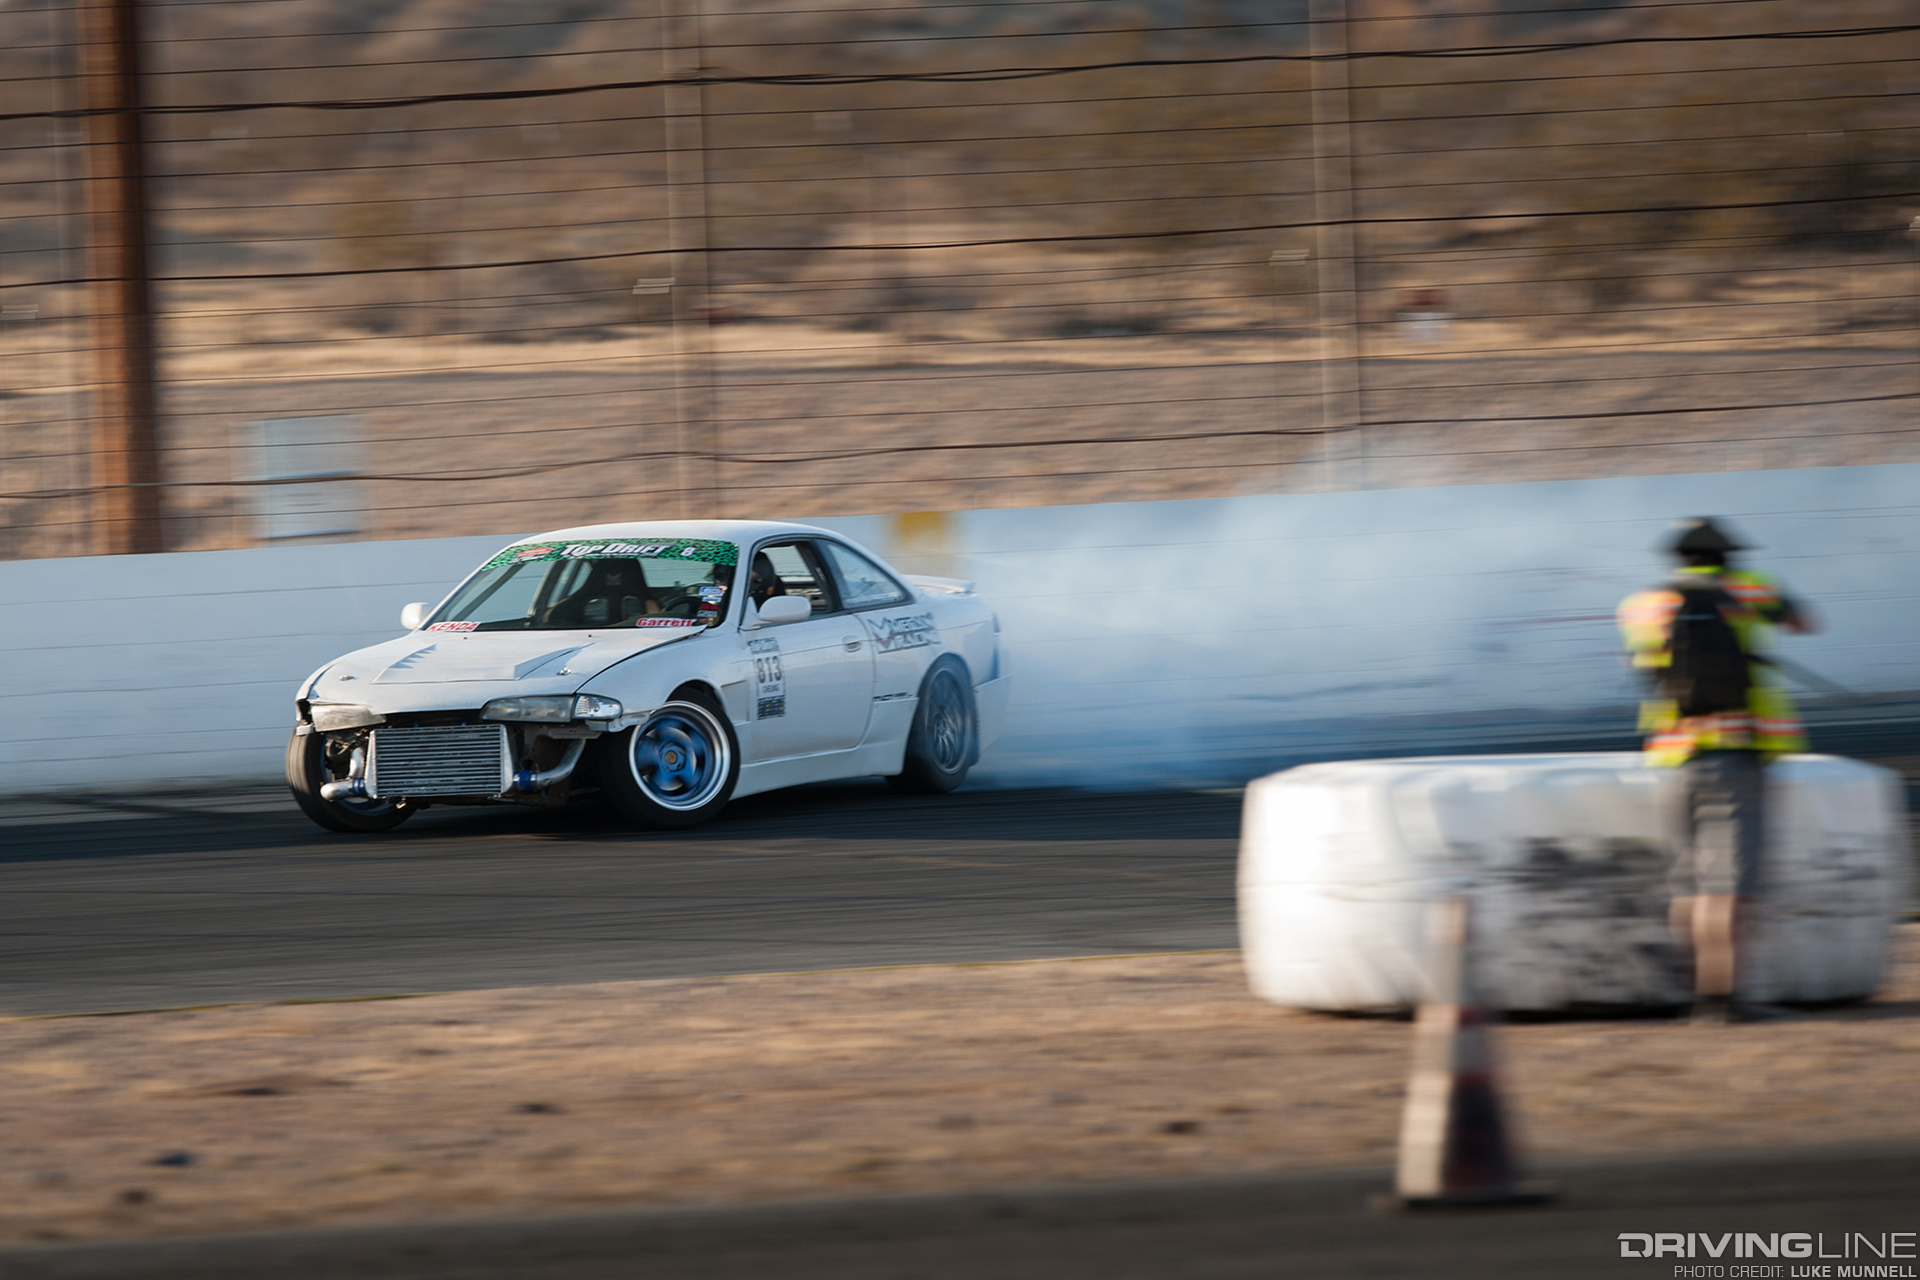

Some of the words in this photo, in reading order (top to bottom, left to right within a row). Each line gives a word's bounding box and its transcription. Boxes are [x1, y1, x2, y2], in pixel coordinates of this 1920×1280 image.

[560, 544, 604, 556] TOP
[601, 543, 672, 557] DRIFT
[680, 547, 696, 557] 8
[426, 622, 479, 632] KENDA
[637, 617, 693, 627] Garrett
[756, 655, 782, 683] 813
